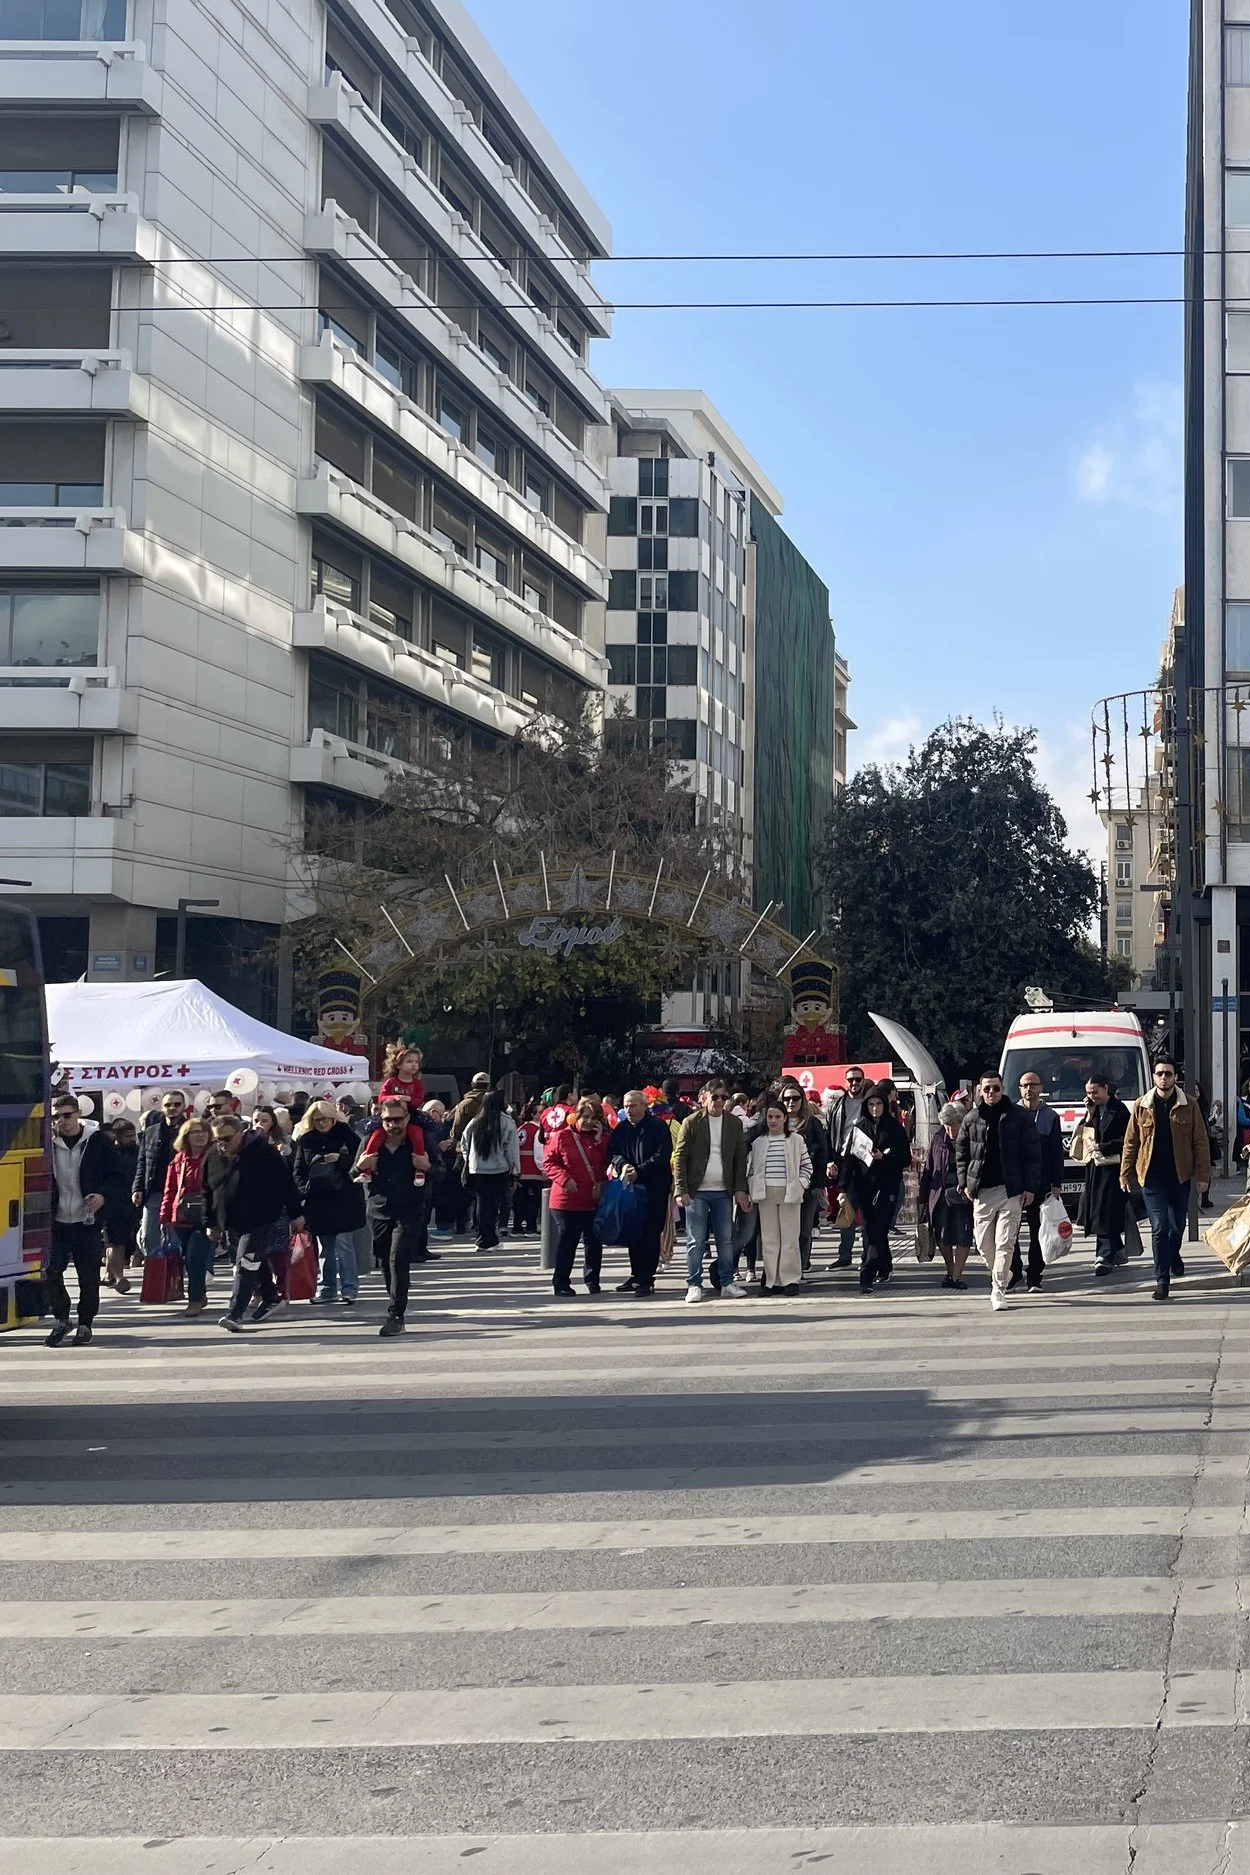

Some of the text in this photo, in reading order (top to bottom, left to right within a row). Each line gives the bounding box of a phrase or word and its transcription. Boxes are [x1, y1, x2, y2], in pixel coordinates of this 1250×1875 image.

[81, 1064, 173, 1080] ΣΤΑΥΡΟΣ
[313, 1067, 326, 1076] RED
[327, 1066, 348, 1076] CROSS
